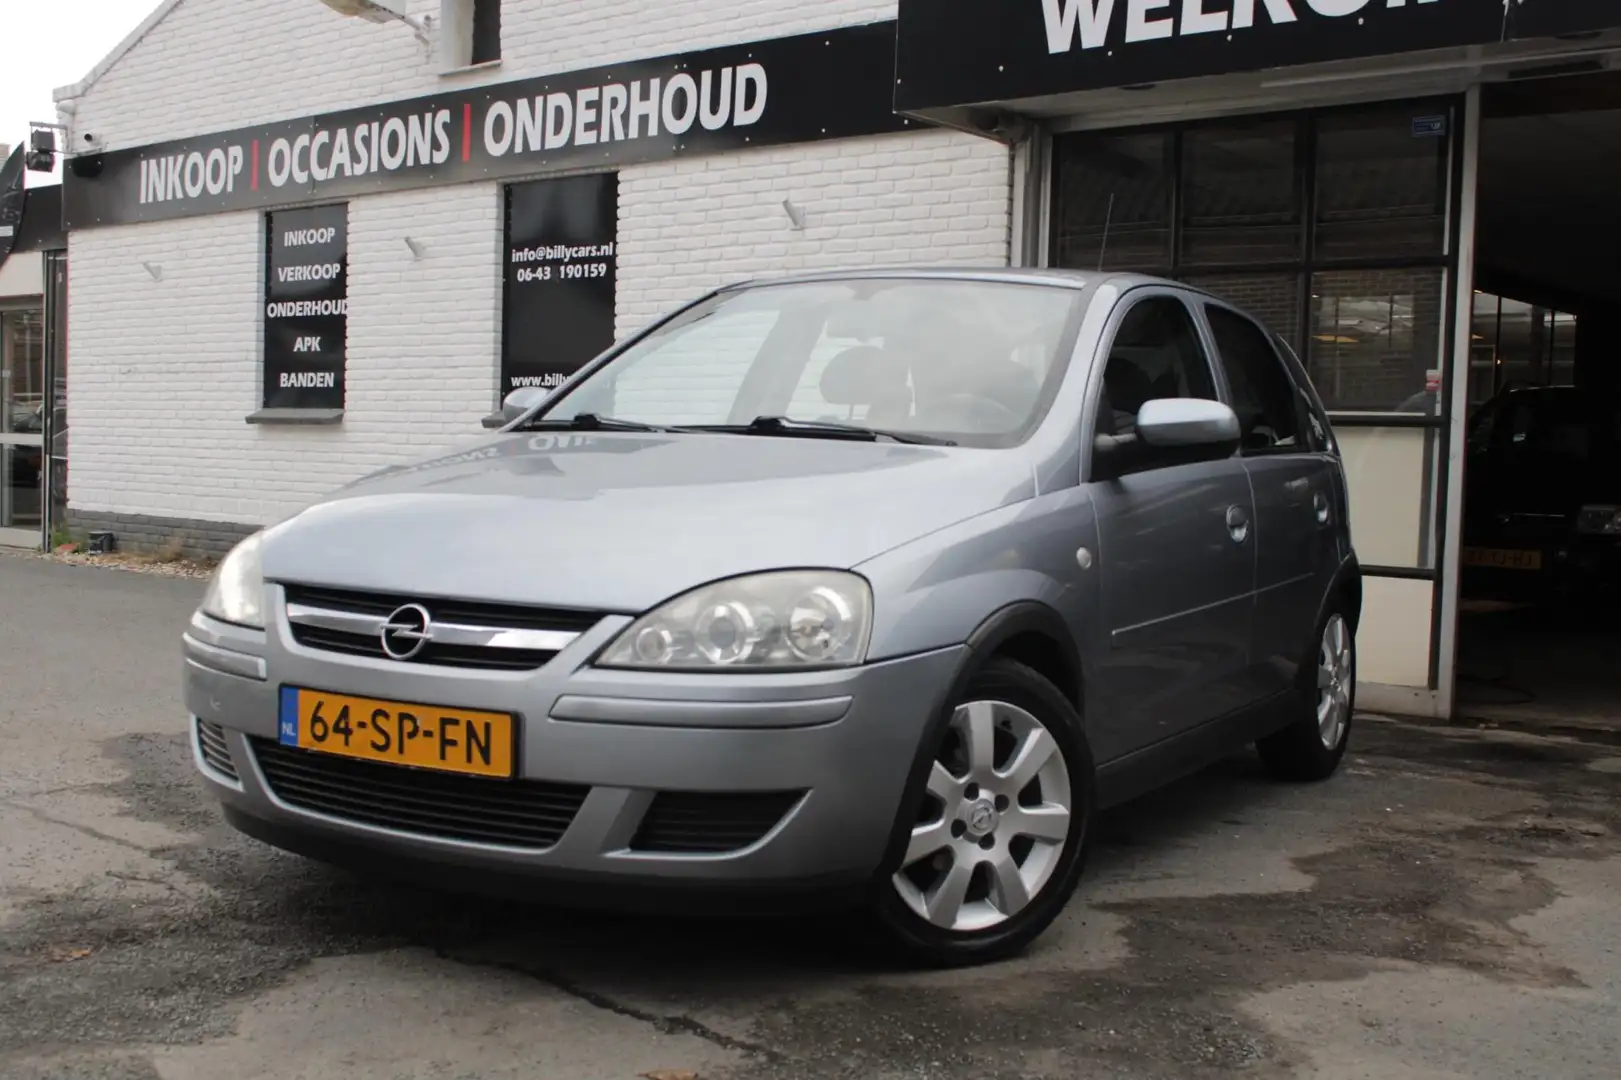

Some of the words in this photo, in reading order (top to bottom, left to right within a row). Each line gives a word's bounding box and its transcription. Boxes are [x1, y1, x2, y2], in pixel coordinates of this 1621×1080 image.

[140, 145, 244, 204] INKOOP
[267, 109, 451, 187] OCCASIONS
[484, 63, 768, 156] ONDERHOUD
[284, 228, 335, 247] INKOOP
[511, 242, 614, 263] info@billycars.nl
[278, 263, 341, 282] VERKOOP
[517, 266, 551, 282] 06-43
[559, 263, 607, 279] 190159
[267, 299, 347, 318] ONDERHOUD
[293, 336, 321, 352] APK
[280, 372, 335, 388] BANDEN
[282, 721, 296, 737] NL
[310, 701, 492, 766] 64-SP-FN
